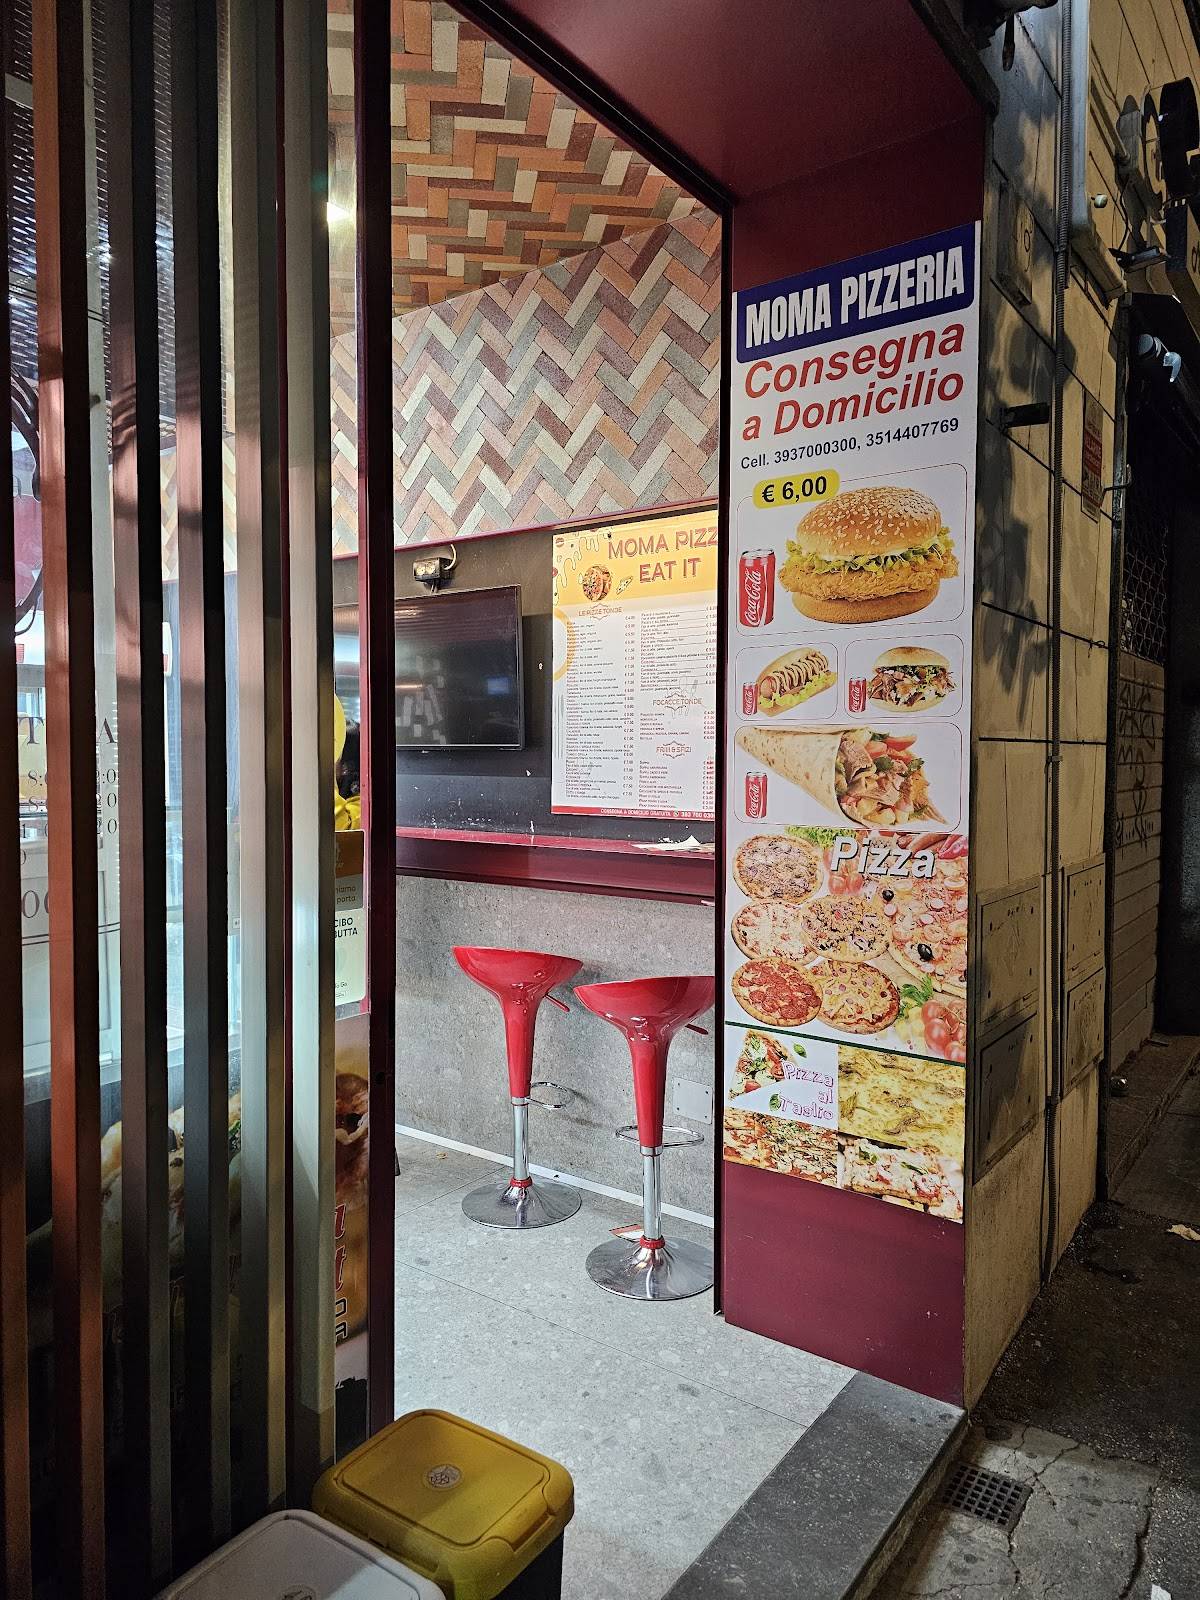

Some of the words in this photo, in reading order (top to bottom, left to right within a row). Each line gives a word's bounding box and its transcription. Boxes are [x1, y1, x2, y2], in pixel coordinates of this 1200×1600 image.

[745, 283, 832, 348] MOMA
[840, 245, 965, 324] PIZZERIA
[744, 323, 965, 399] Consegna
[742, 415, 762, 441] a
[773, 367, 964, 435] Domicilio
[741, 453, 770, 470] Cell.
[774, 437, 861, 463] 3937000300,
[866, 417, 959, 447] 3514407769
[762, 484, 776, 503] €
[782, 476, 828, 502] 6,00
[608, 534, 669, 560] MOMA
[640, 560, 677, 584] EAT
[683, 557, 701, 578] IT
[831, 837, 936, 878] Pizza
[782, 1061, 834, 1088] Pizza
